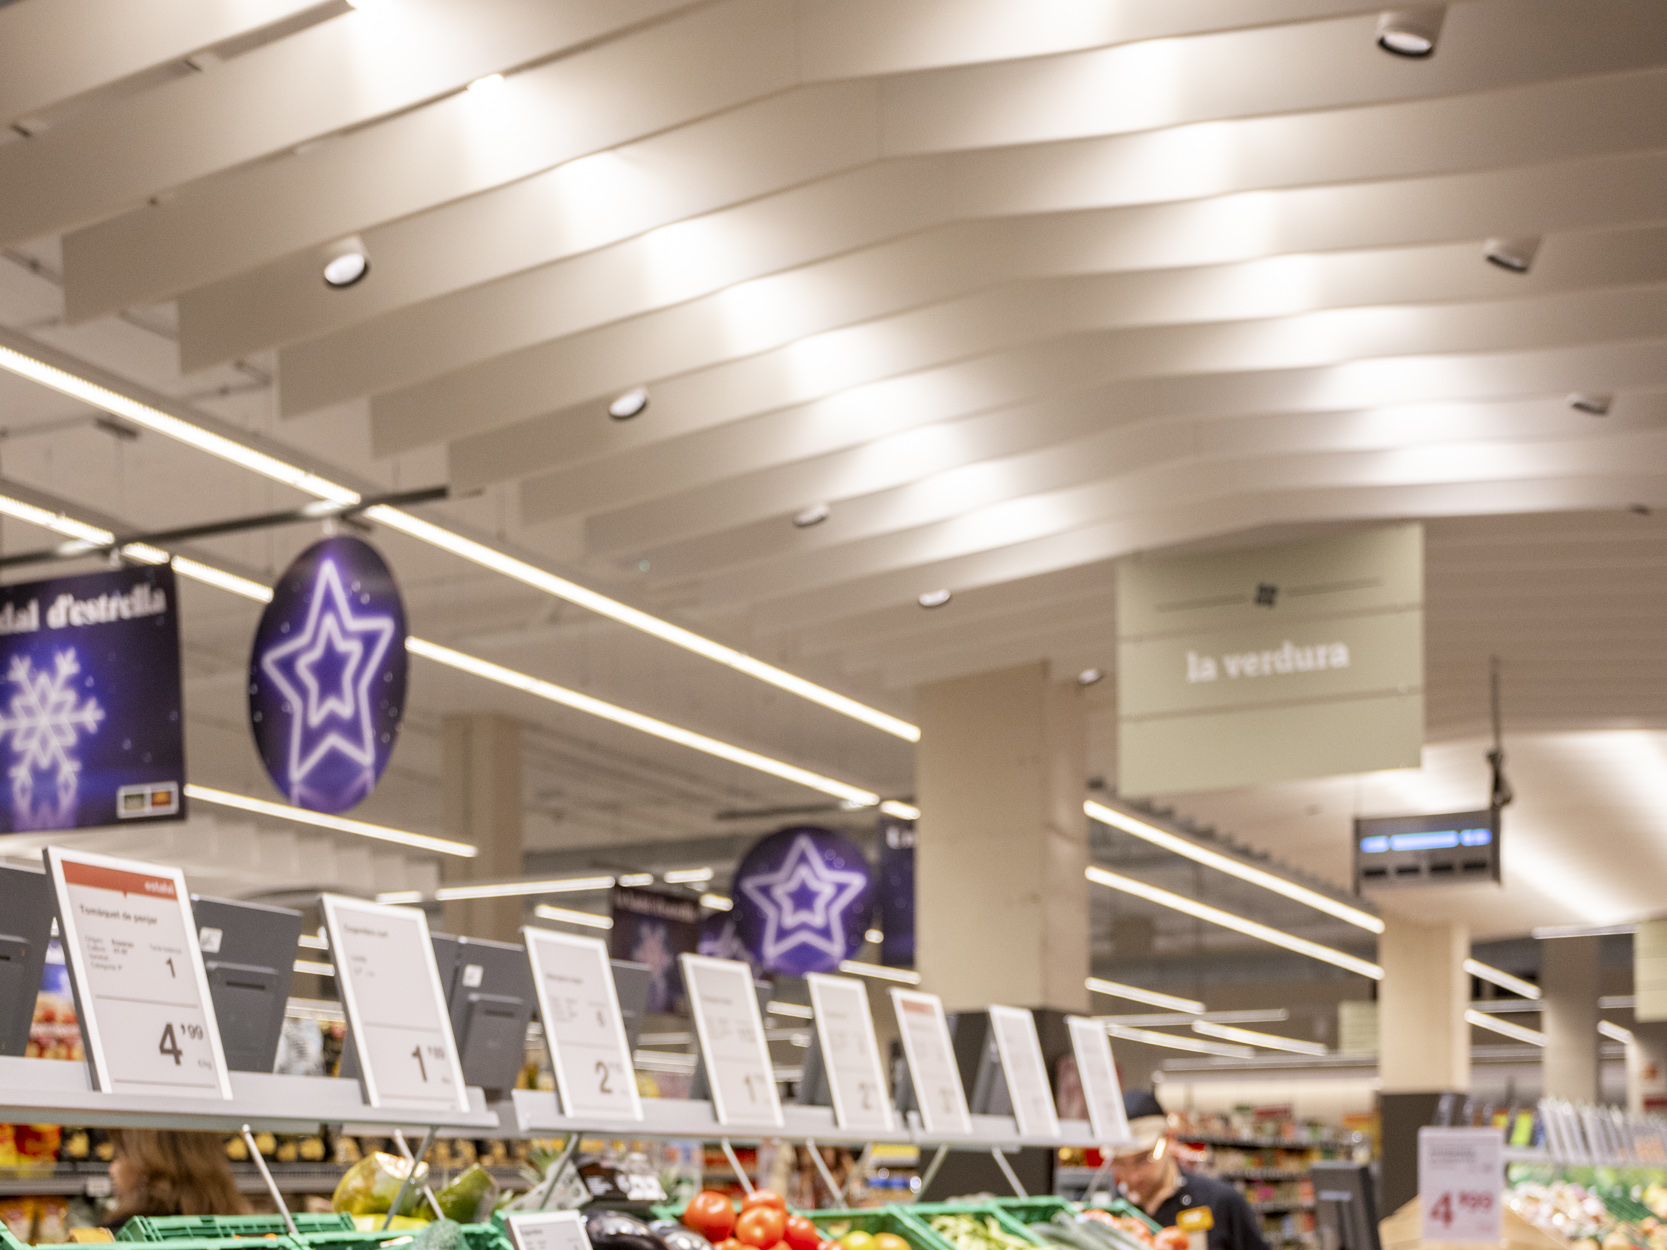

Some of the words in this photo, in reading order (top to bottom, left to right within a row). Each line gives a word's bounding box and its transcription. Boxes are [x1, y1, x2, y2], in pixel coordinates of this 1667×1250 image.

[1187, 651, 1217, 683] la
[1223, 640, 1350, 678] verdura
[165, 957, 176, 979] 1
